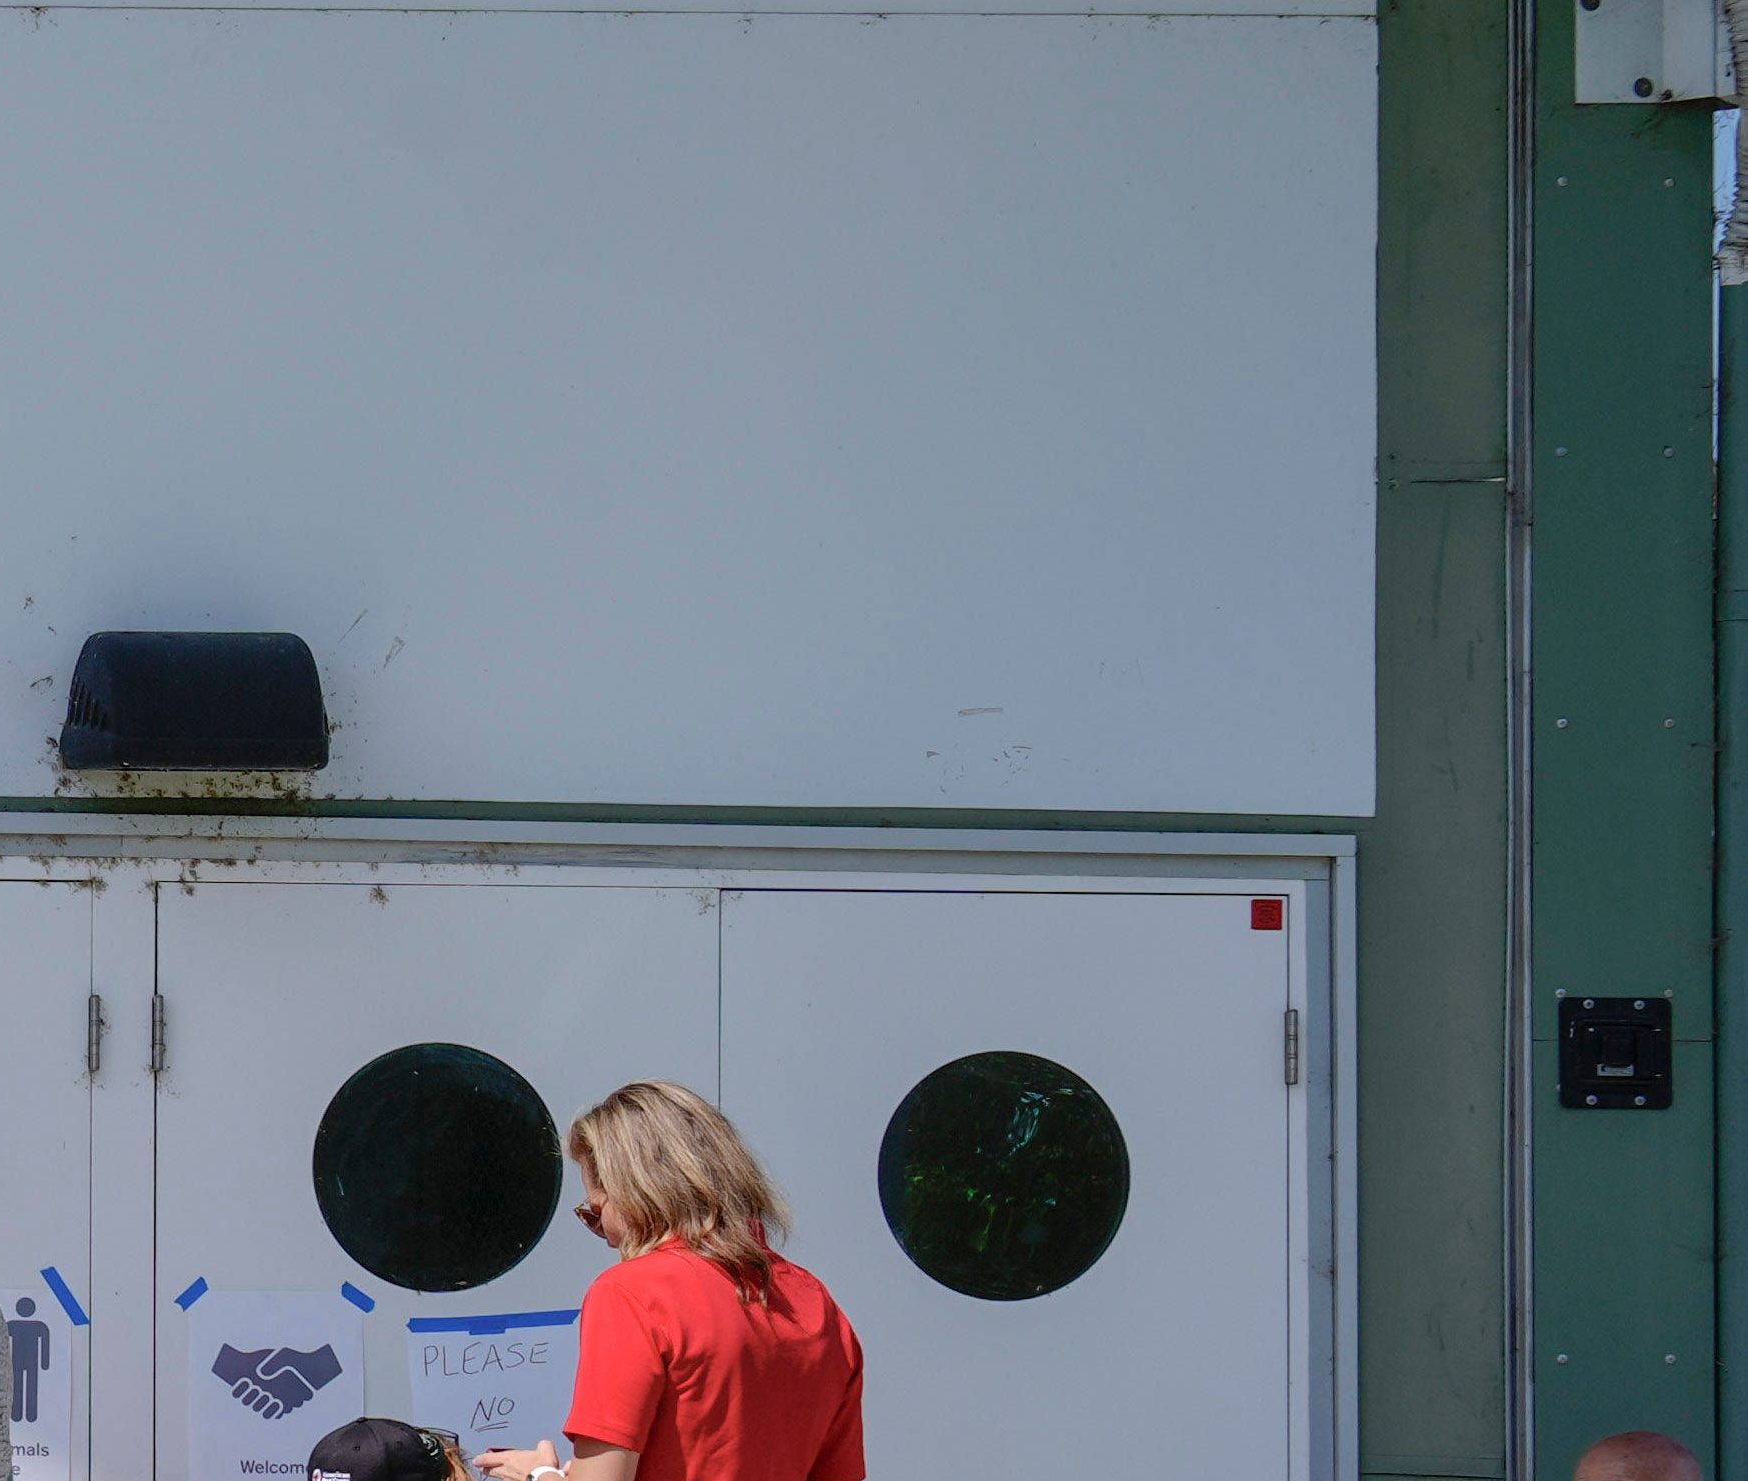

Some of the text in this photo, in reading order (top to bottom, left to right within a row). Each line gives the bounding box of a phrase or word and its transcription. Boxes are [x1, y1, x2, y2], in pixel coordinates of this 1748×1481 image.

[423, 1341, 549, 1377] PLEASE
[470, 1396, 515, 1429] NO
[240, 1460, 308, 1474] Welcom
